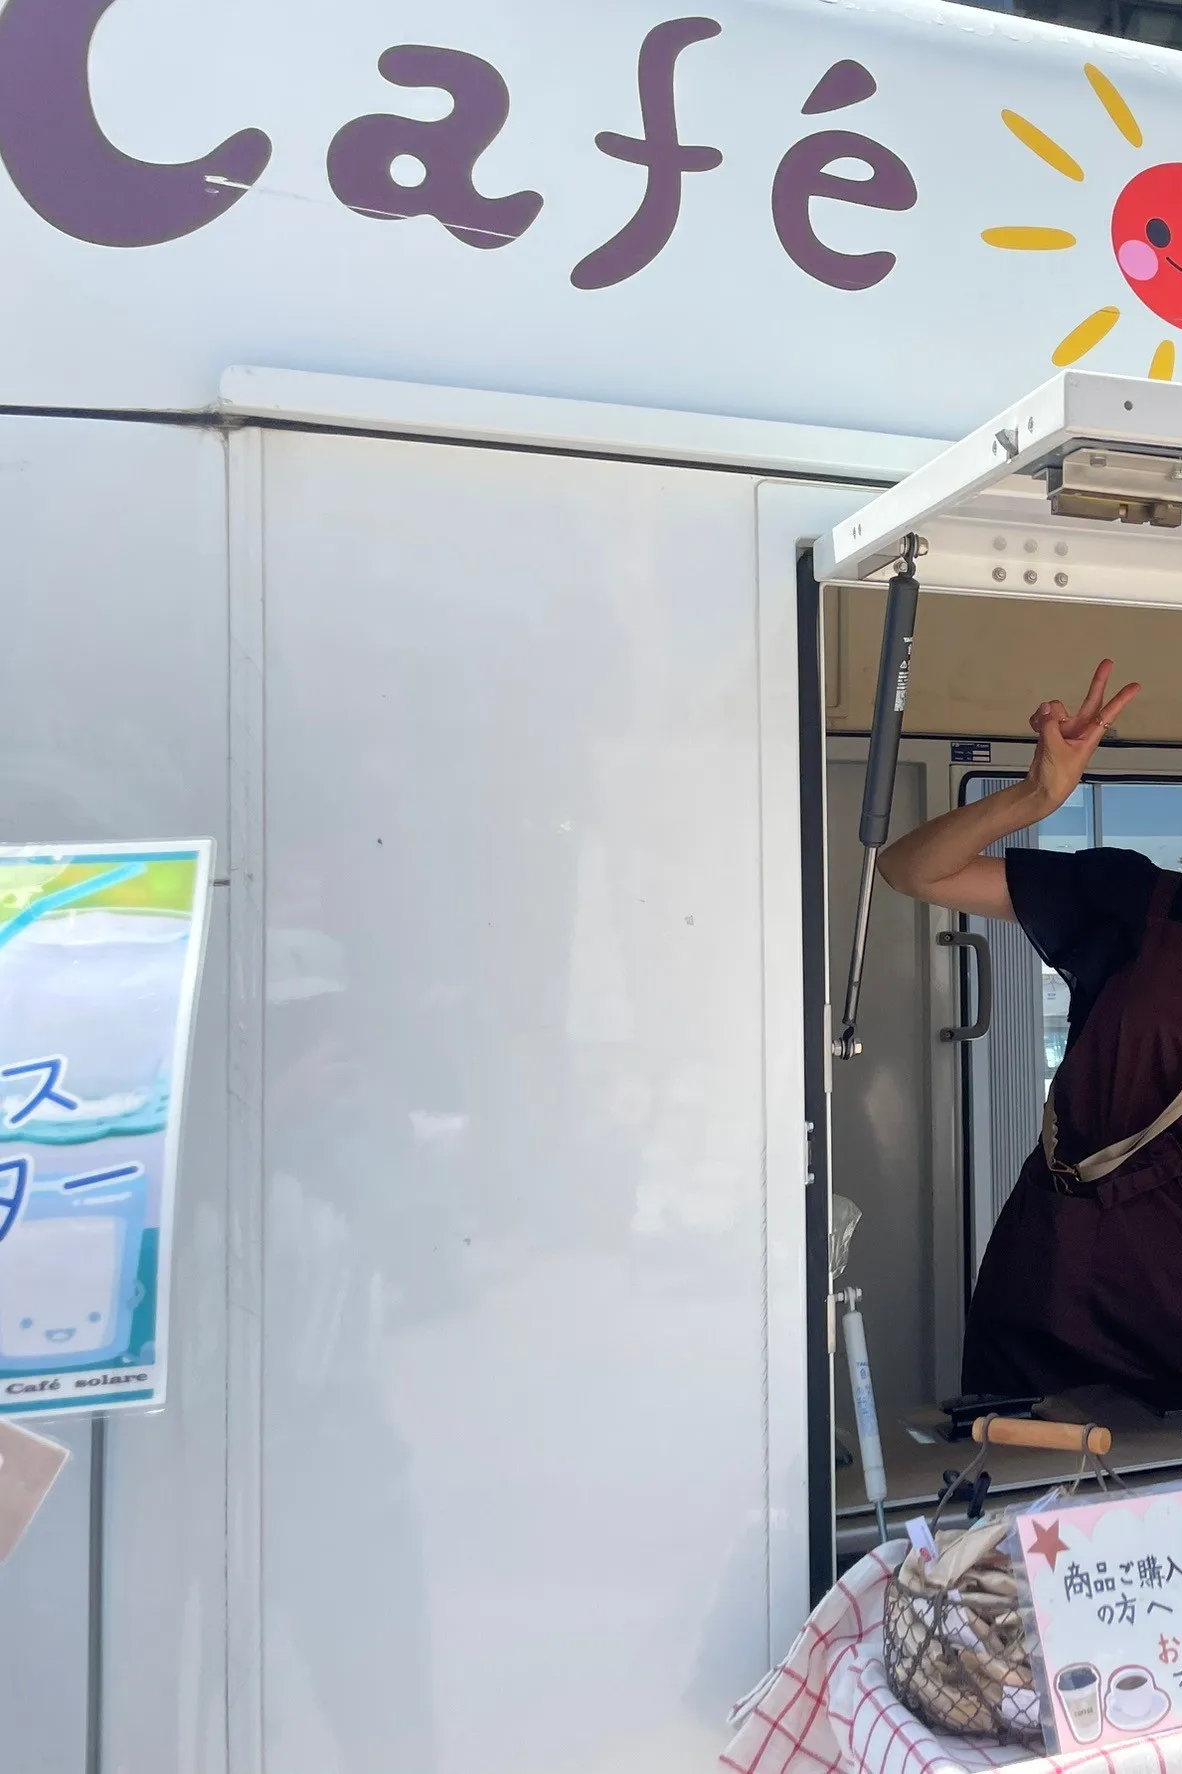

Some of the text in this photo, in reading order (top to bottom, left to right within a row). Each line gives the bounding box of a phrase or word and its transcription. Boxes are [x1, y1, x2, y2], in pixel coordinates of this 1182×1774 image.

[0, 0, 915, 291] Café
[6, 1372, 149, 1394] Café solare
[1097, 1593, 1174, 1626] の方へ
